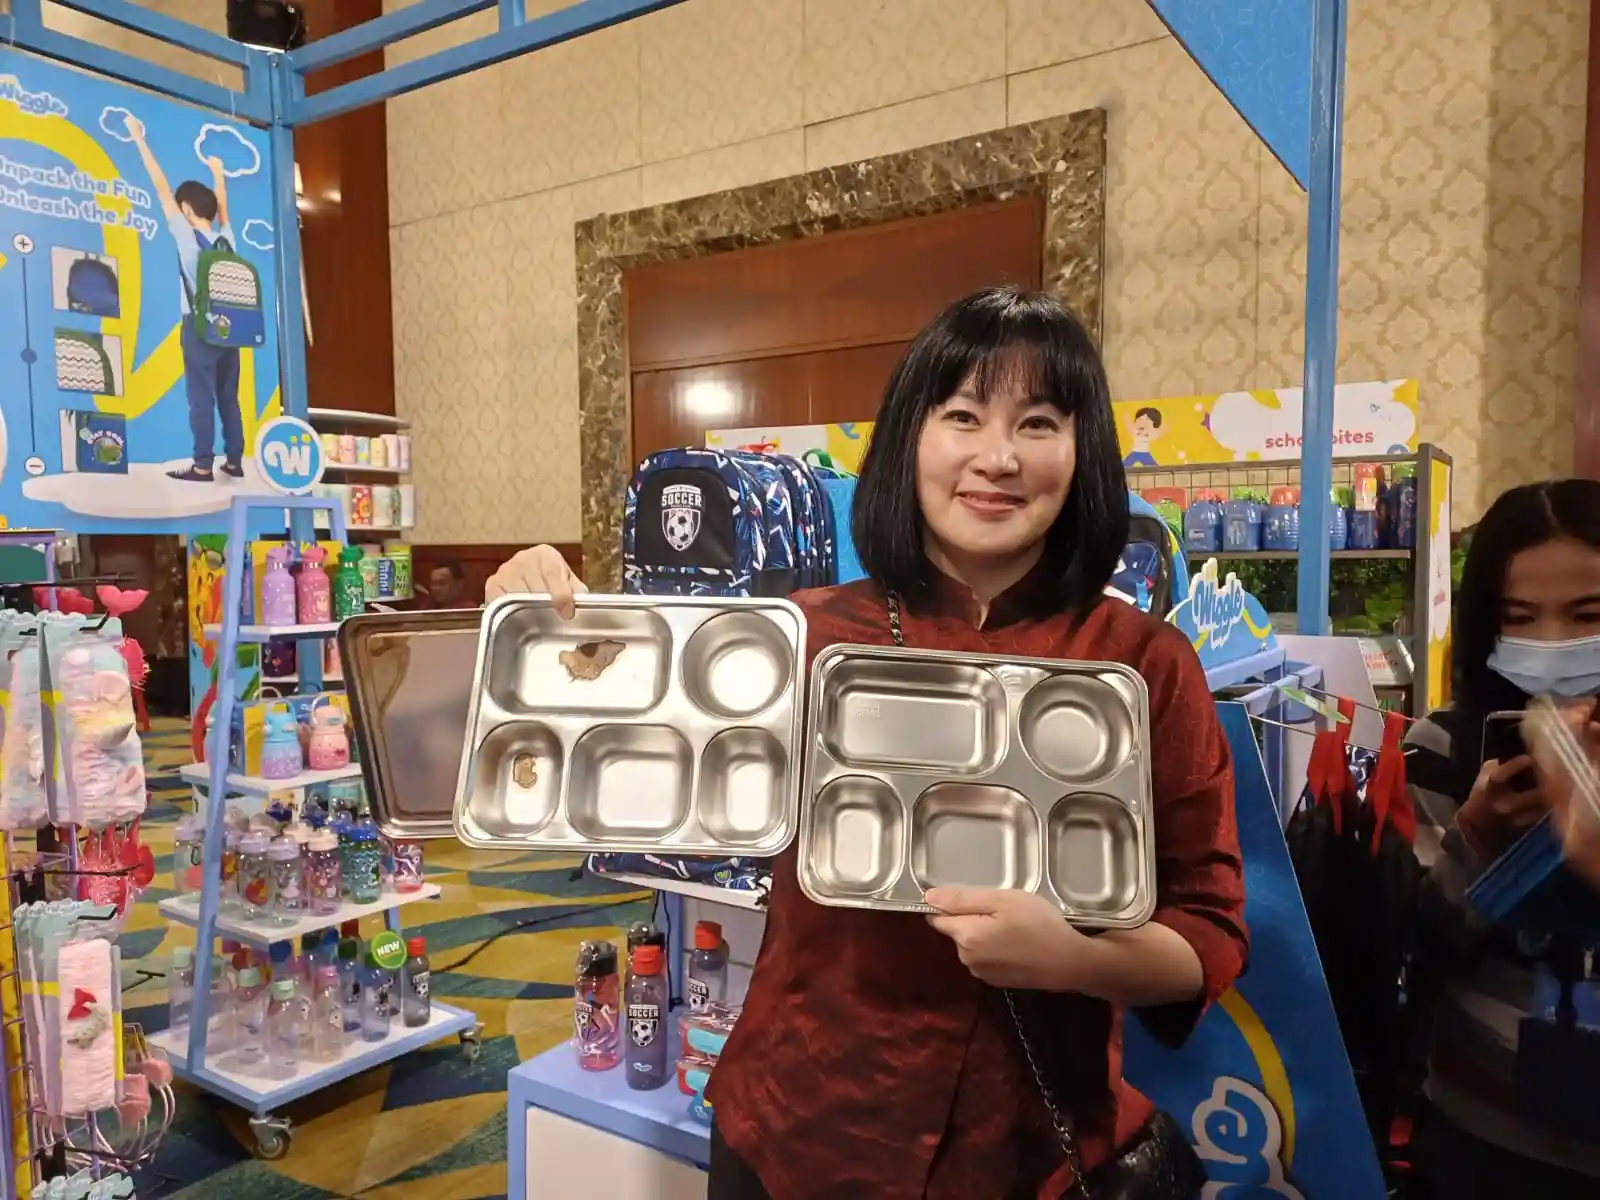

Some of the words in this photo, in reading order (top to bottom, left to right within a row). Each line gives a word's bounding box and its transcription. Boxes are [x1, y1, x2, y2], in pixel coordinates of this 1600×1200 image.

[73, 172, 108, 193] the
[113, 180, 150, 207] Fun
[82, 203, 117, 223] the
[123, 209, 157, 238] Joy
[661, 492, 702, 507] SOCCER
[377, 941, 400, 956] NEW
[628, 1008, 659, 1017] SOCCER
